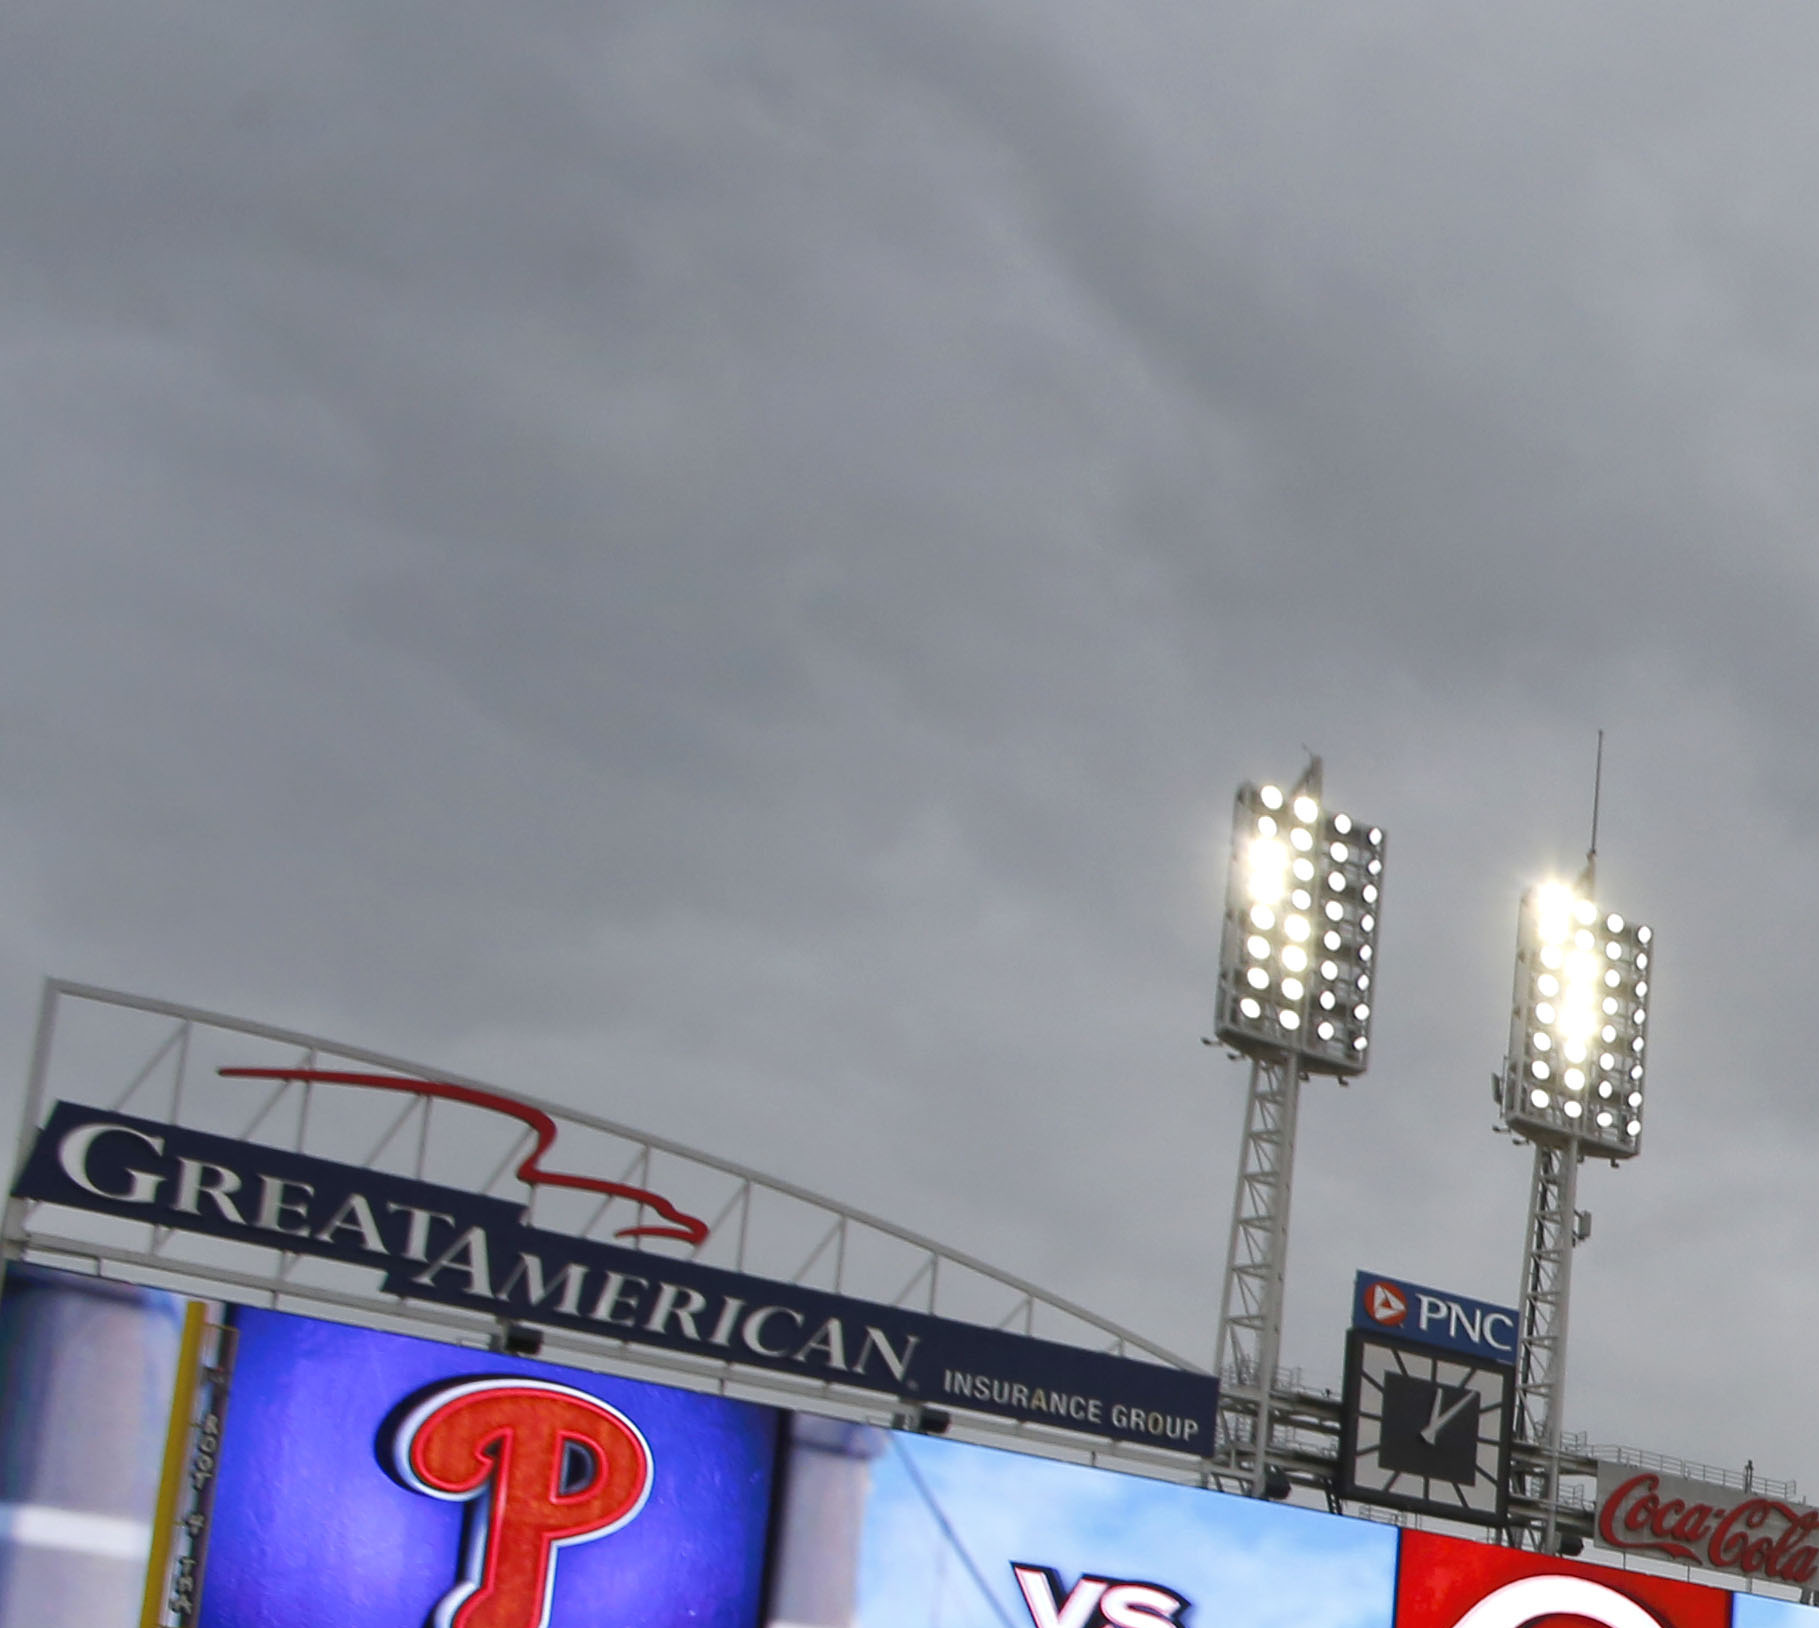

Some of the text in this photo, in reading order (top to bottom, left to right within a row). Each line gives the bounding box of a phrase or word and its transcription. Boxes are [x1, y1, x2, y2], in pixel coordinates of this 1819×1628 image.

[1418, 1293, 1513, 1354] PNC
[943, 1368, 1200, 1445] INSURANCE GROUP
